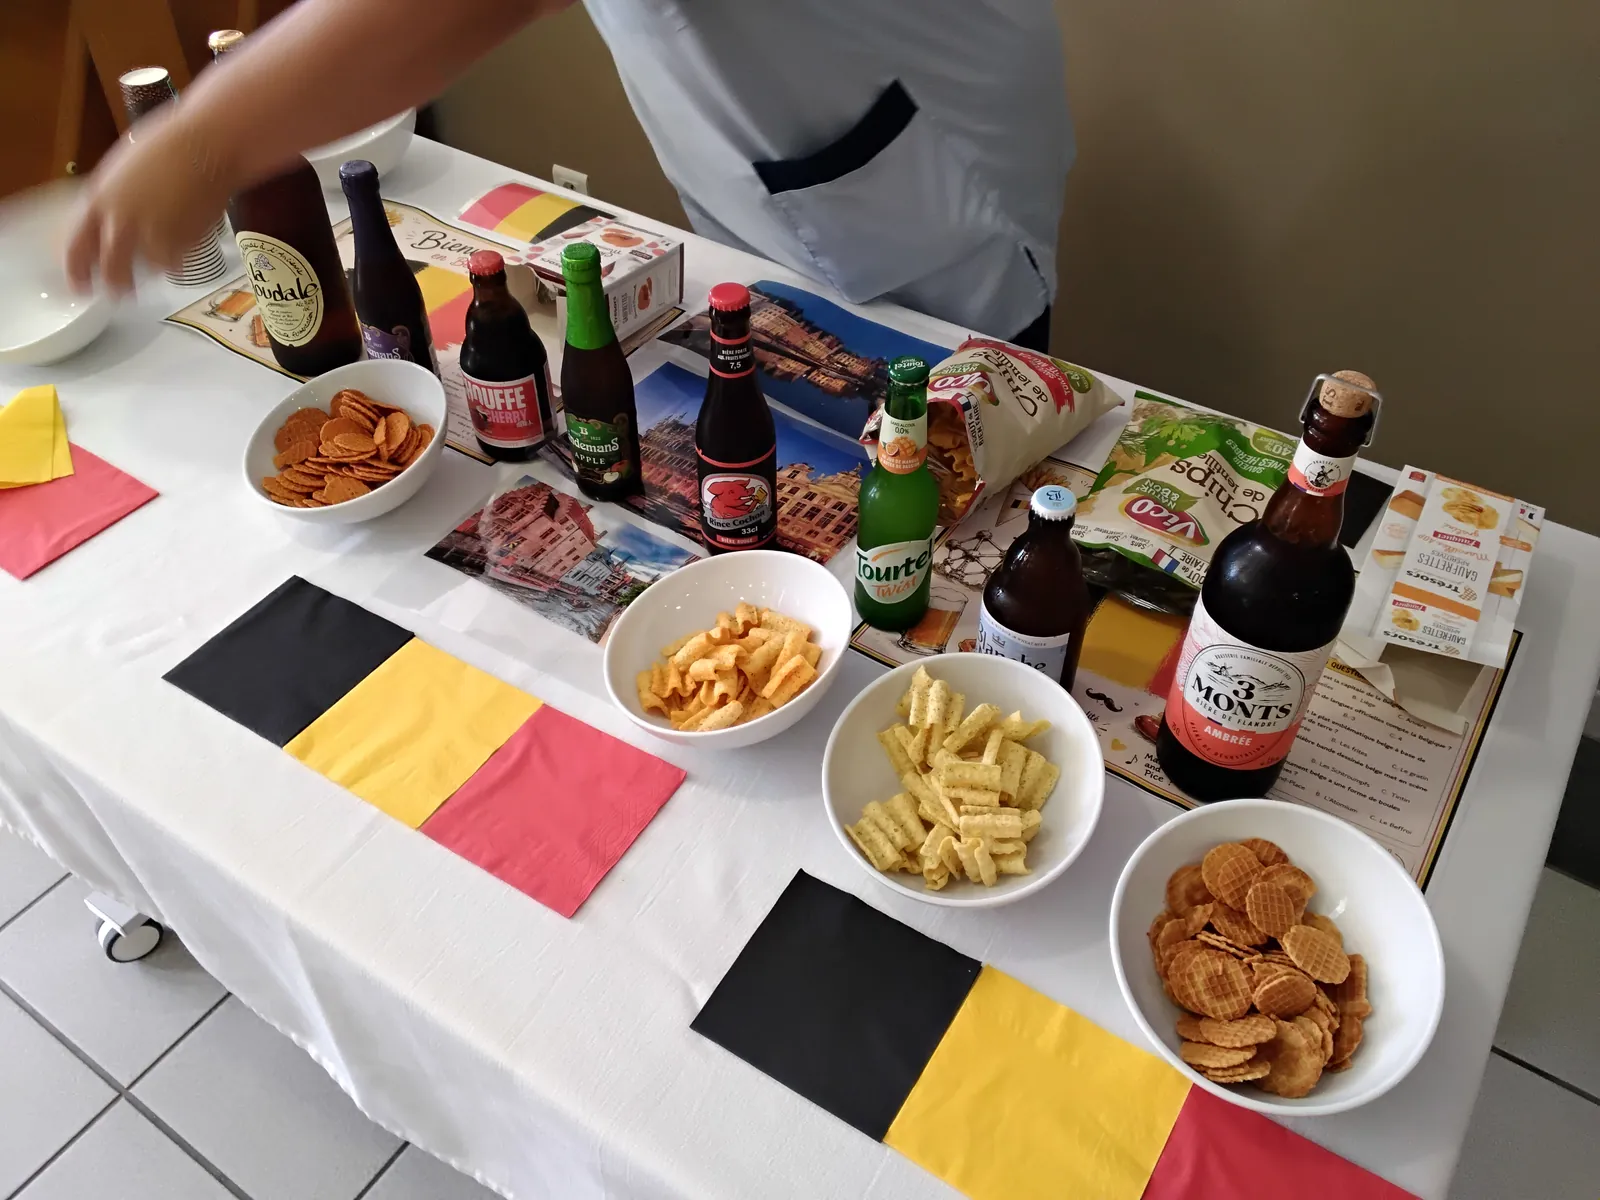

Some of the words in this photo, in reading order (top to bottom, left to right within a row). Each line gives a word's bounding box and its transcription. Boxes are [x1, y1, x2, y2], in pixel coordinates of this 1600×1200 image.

[254, 277, 319, 302] oudale
[895, 361, 925, 370] Tourtel
[464, 380, 526, 411] HOUFFE
[1033, 386, 1049, 403] de
[575, 452, 606, 465] APPLE
[1170, 460, 1259, 525] Chips
[1242, 488, 1265, 502] de
[709, 518, 731, 527] Rince
[732, 510, 765, 527] Cochon
[1131, 499, 1195, 539] Vico
[741, 526, 758, 534] 33cl
[1071, 529, 1086, 538] Sans
[1130, 539, 1148, 551] Sans
[856, 538, 932, 582] Tourtel
[1179, 552, 1204, 568] FAIRE
[1418, 552, 1478, 581] GAUFRETTES
[871, 575, 917, 598] Twist
[1407, 570, 1460, 593] Trésors
[1384, 631, 1441, 650] Trésors
[1422, 625, 1466, 645] GAUFRETTES
[977, 622, 1046, 672] Blahe
[1192, 673, 1293, 721] MONTS
[1232, 680, 1255, 700] 3
[1085, 710, 1099, 722] lité
[1237, 719, 1276, 728] FLANDRE
[1354, 707, 1385, 724] officielles
[1204, 725, 1252, 746] AMBRÉE
[1295, 734, 1315, 746] élèbre
[1316, 742, 1336, 755] bande
[1336, 751, 1365, 767] dessinée
[1351, 746, 1369, 757] frites
[1144, 769, 1164, 782] Pice
[1277, 775, 1306, 791] nd-Place
[1284, 759, 1309, 773] nument
[1378, 799, 1402, 813] boules
